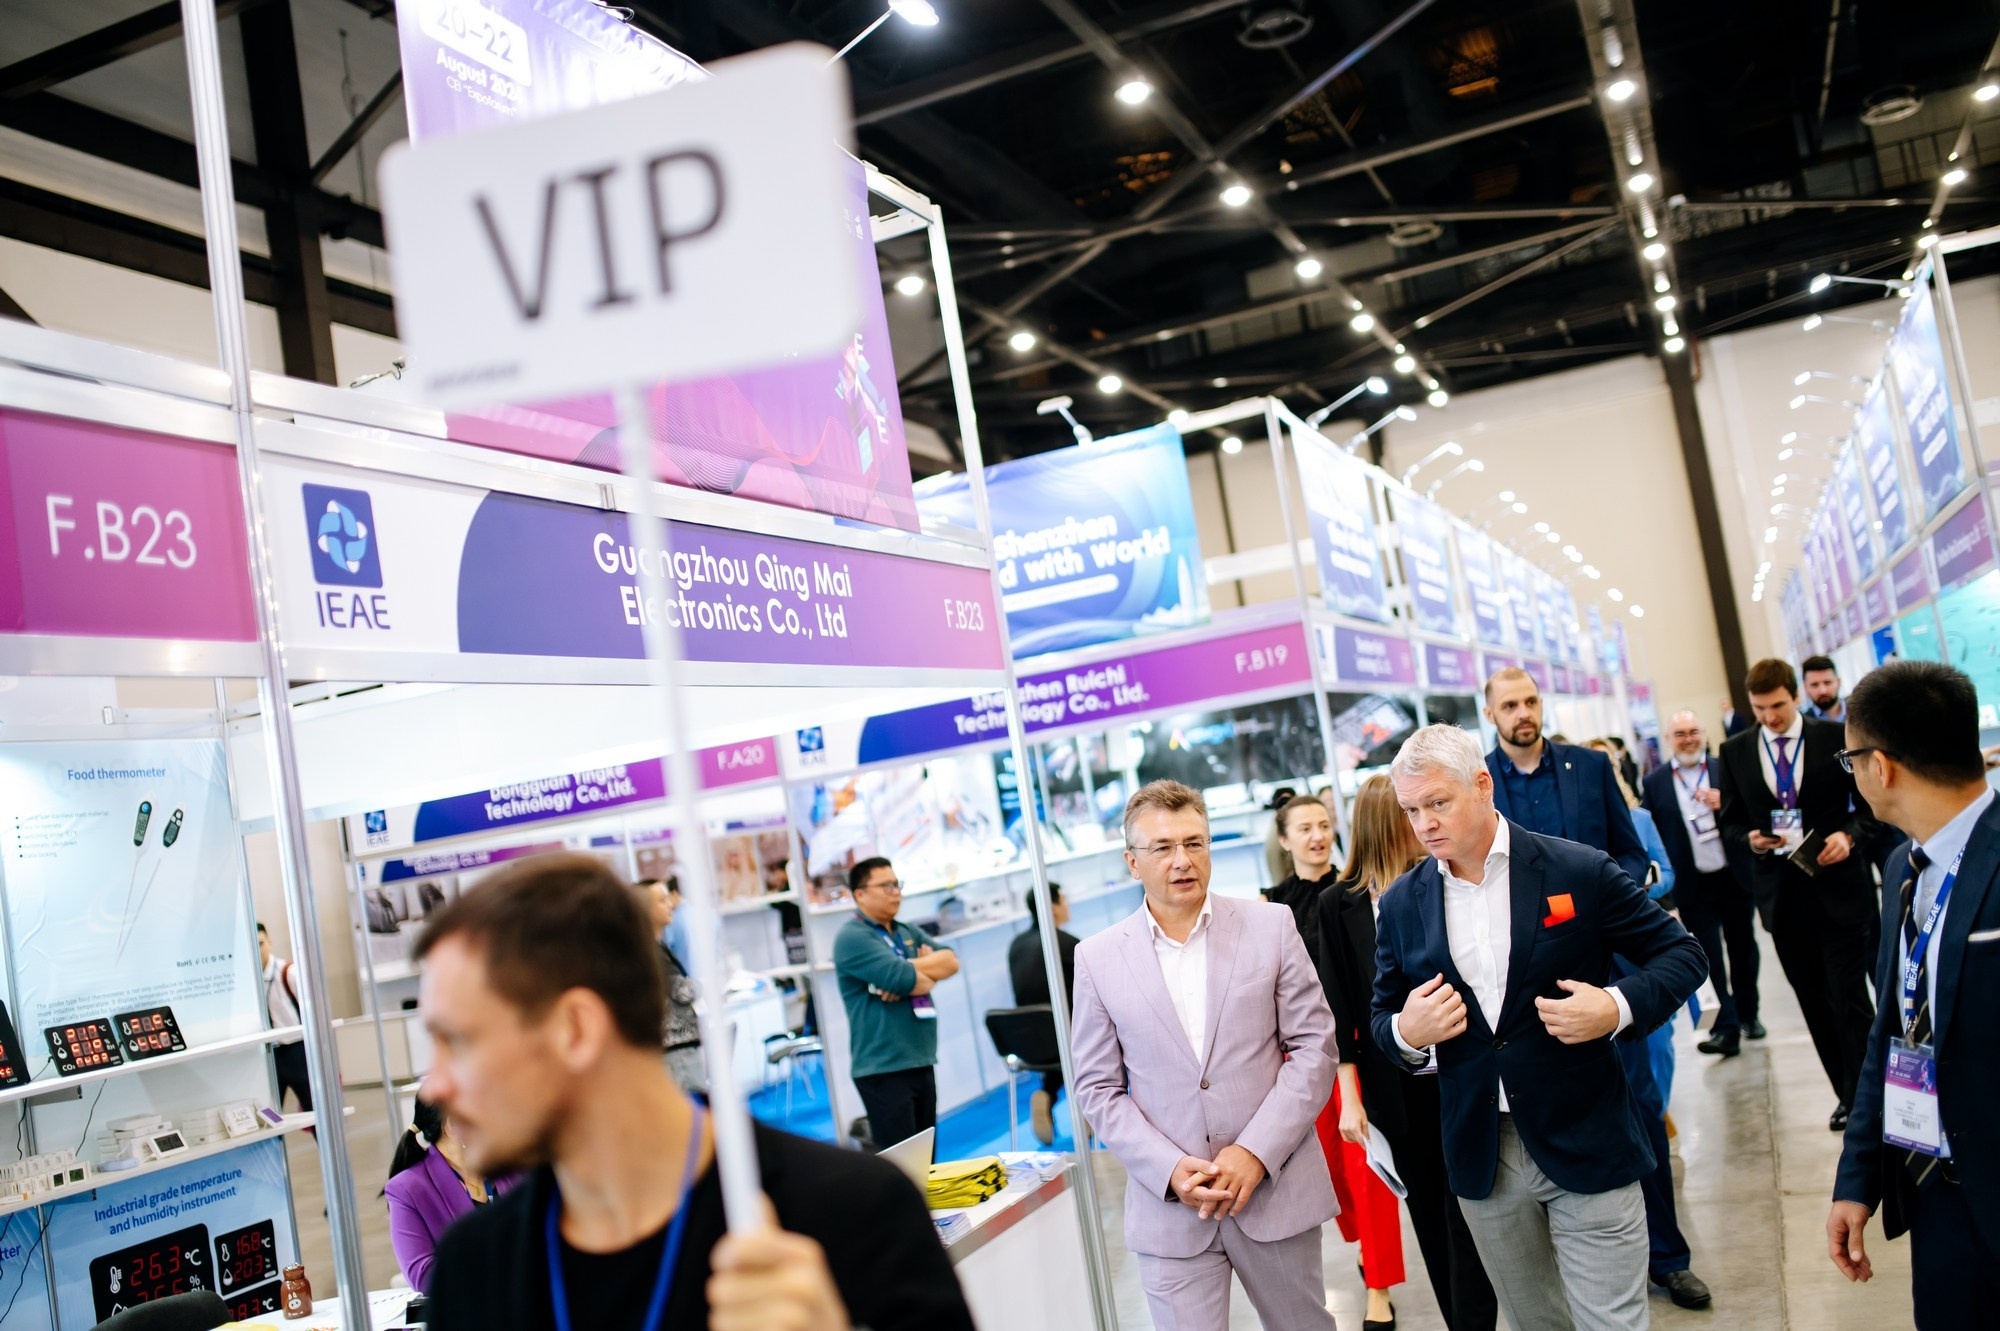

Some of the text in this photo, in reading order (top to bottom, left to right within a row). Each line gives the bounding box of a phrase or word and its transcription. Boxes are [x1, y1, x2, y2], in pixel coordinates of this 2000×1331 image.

[436, 48, 487, 87] August
[472, 147, 727, 321] VIP
[46, 494, 198, 568] F.B23
[993, 515, 1118, 560] Shenzhen
[1024, 547, 1085, 582] with
[1090, 525, 1171, 568] World
[755, 553, 810, 602] Qing
[813, 561, 853, 598] Mai
[315, 590, 391, 630] IEAE
[767, 598, 813, 640] Co.,
[815, 602, 848, 639] Ltd
[944, 598, 984, 632] F.B23
[1234, 644, 1288, 674] F.B19
[954, 700, 1066, 735] Technlogy
[1113, 682, 1150, 706] Ltd.
[972, 664, 1126, 712] Shezhen Ruichi
[67, 766, 166, 781] Food thermometer
[716, 744, 765, 771] F.A20
[484, 790, 575, 822] Technology
[1926, 902, 1941, 927] IEAE
[1909, 960, 1919, 985] IEAE
[94, 1168, 242, 1222] Industrial grade temperature
[109, 1186, 237, 1236] and humidity instrument
